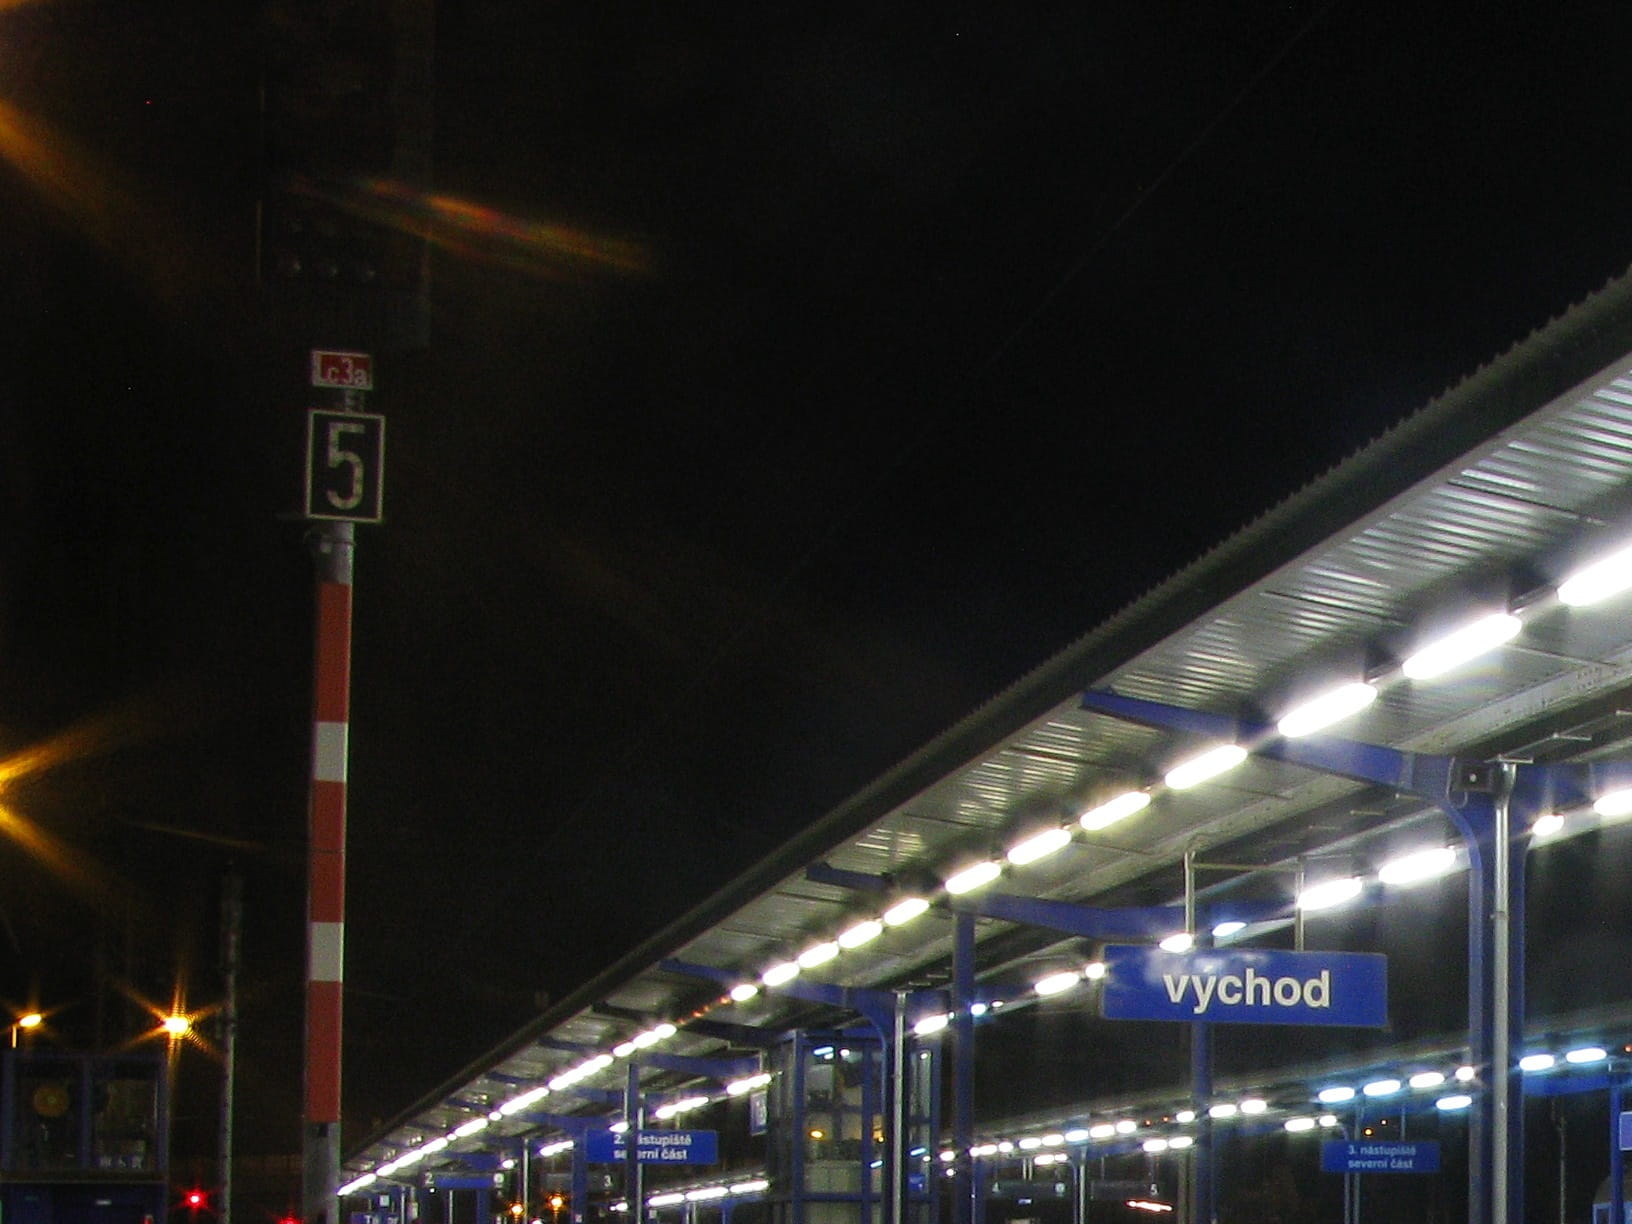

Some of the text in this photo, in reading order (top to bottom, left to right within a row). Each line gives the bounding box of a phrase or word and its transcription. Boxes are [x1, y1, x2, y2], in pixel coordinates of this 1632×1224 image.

[327, 423, 365, 510] 5
[614, 1134, 625, 1145] 2.
[661, 1148, 687, 1160] část
[1390, 1157, 1413, 1169] část
